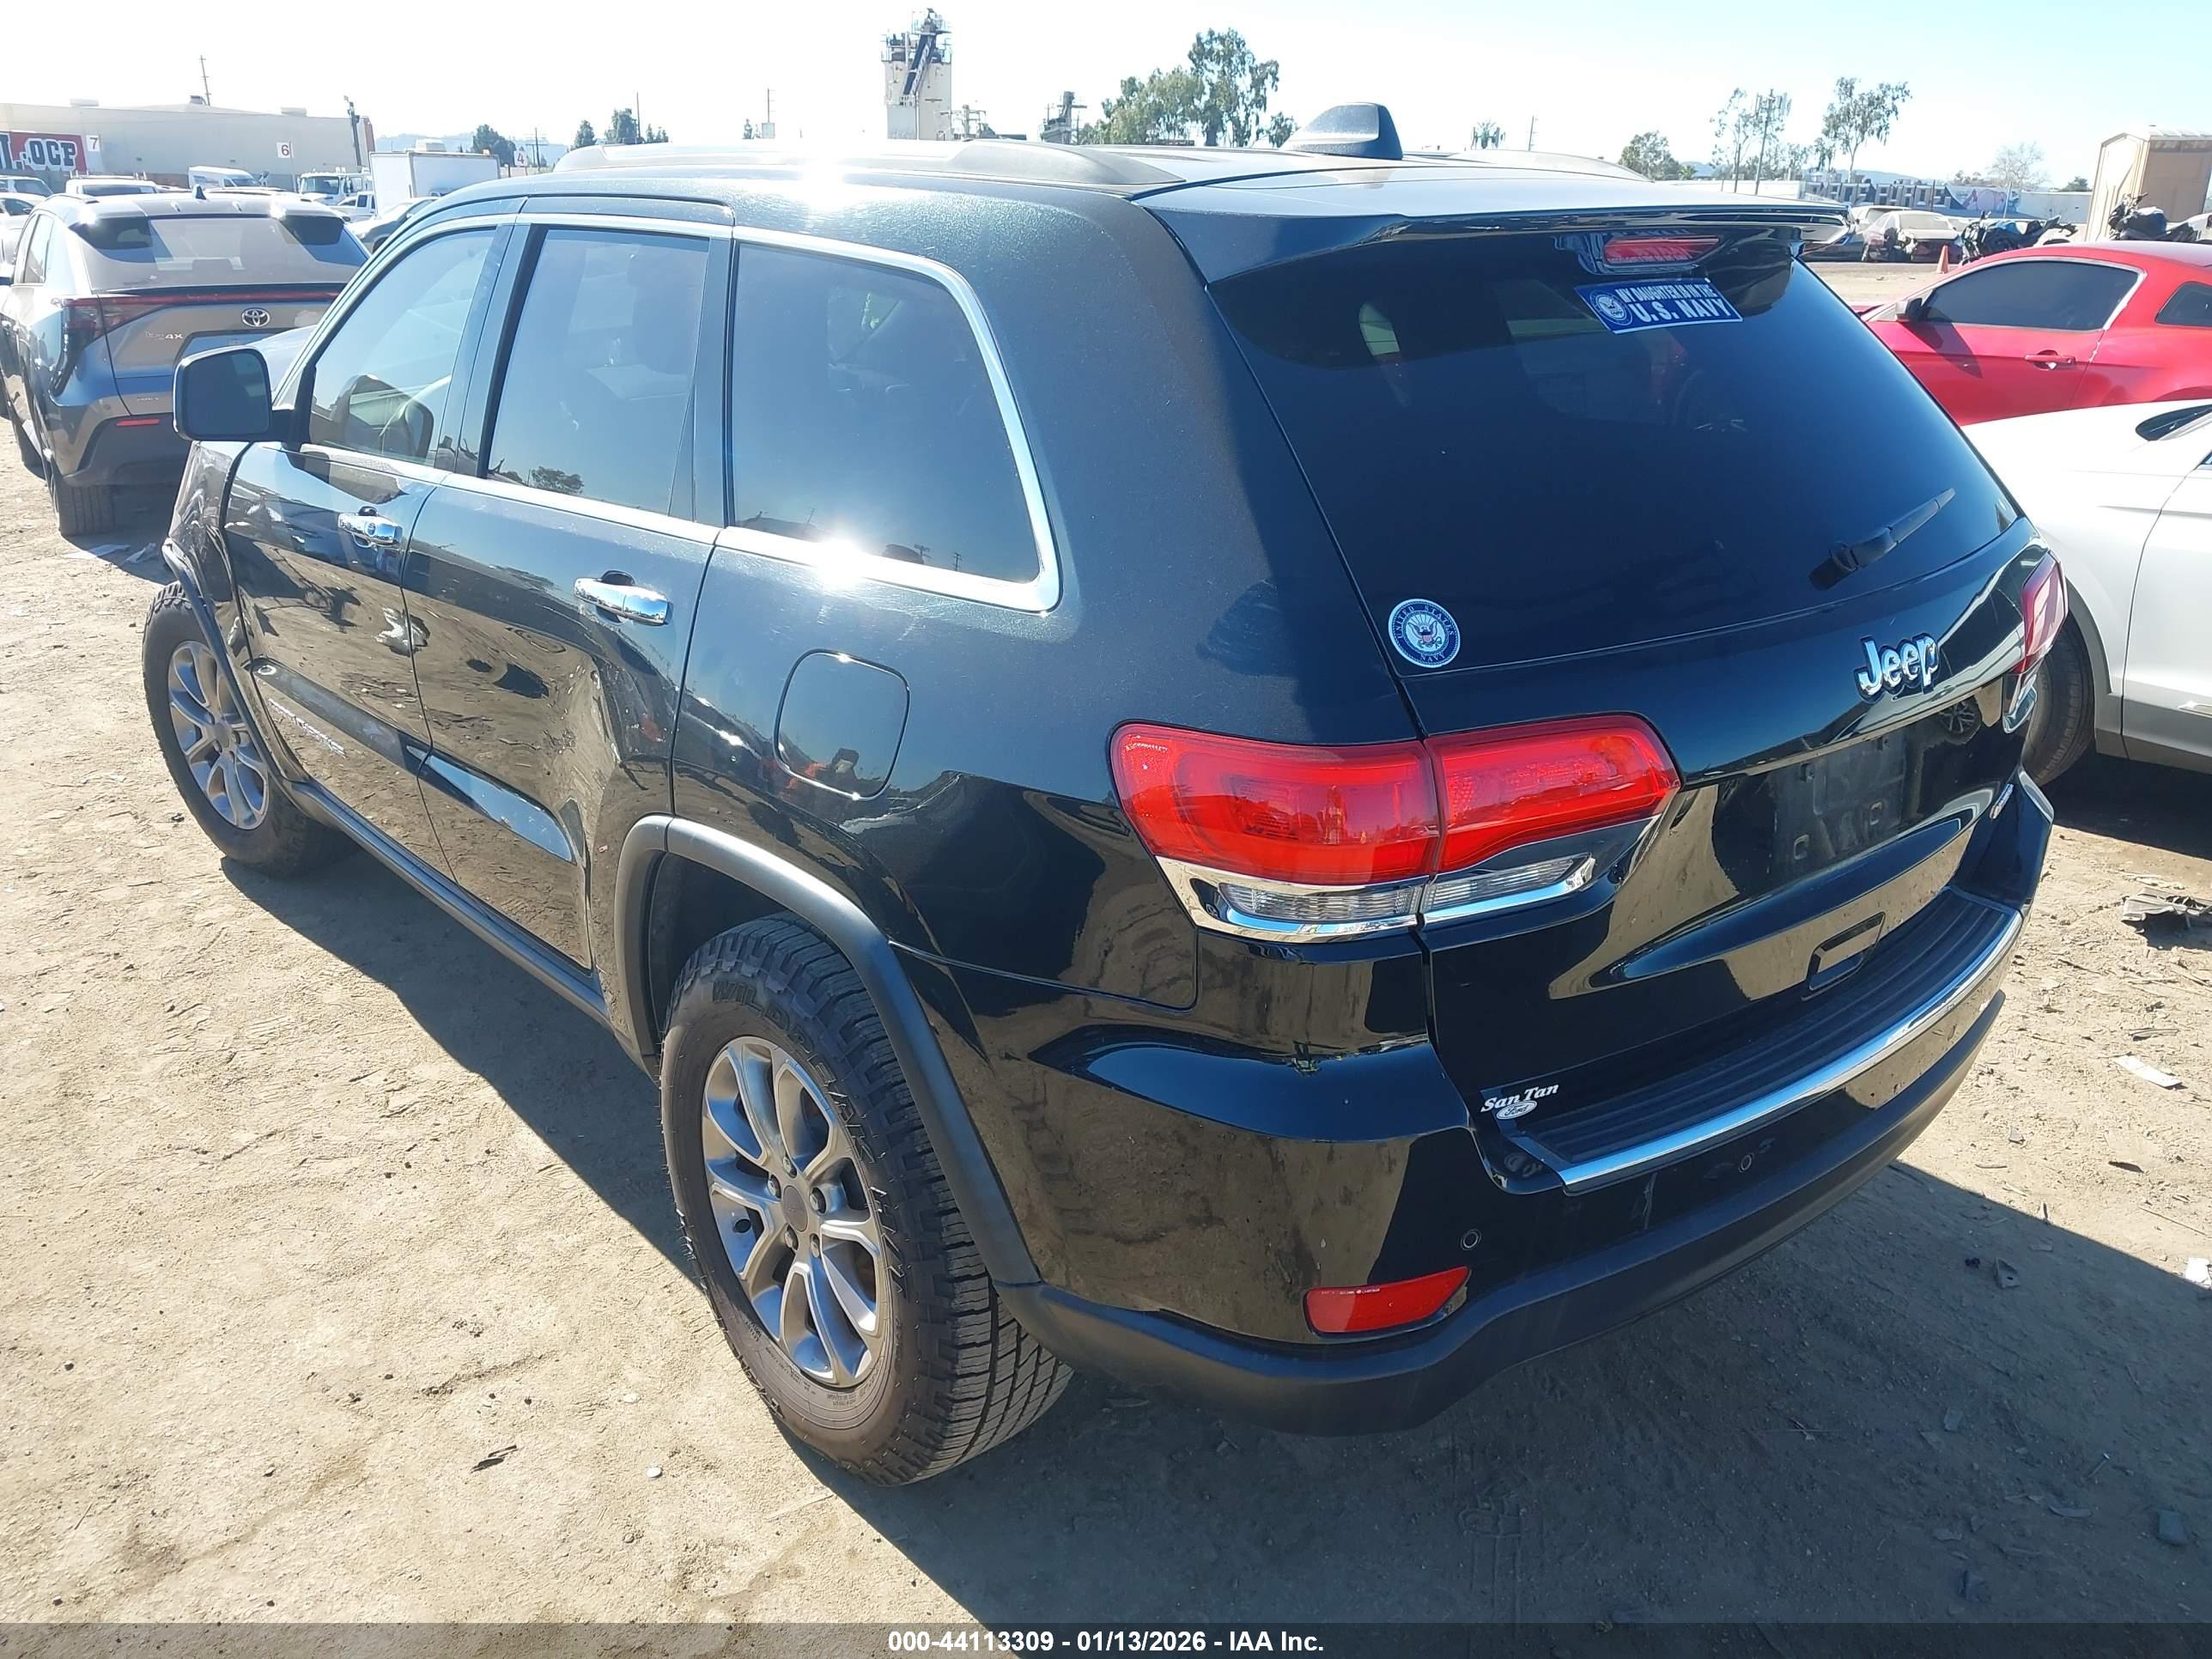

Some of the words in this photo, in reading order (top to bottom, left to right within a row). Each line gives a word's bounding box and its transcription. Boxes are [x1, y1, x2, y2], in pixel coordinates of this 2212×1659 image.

[90, 137, 99, 149] 7
[281, 144, 289, 155] 6
[1614, 288, 1636, 302] MY
[1630, 284, 1683, 301] DAUGHTER
[1693, 284, 1717, 297] THE
[1628, 301, 1680, 322] U.S.
[1674, 299, 1731, 318] NAVY
[1394, 605, 1416, 640] UNITED
[1424, 605, 1455, 636] STATES
[1419, 652, 1445, 663] NAVY
[1855, 634, 1940, 699] Jeep
[1480, 1094, 1521, 1113] San
[1522, 1084, 1559, 1102] Tan
